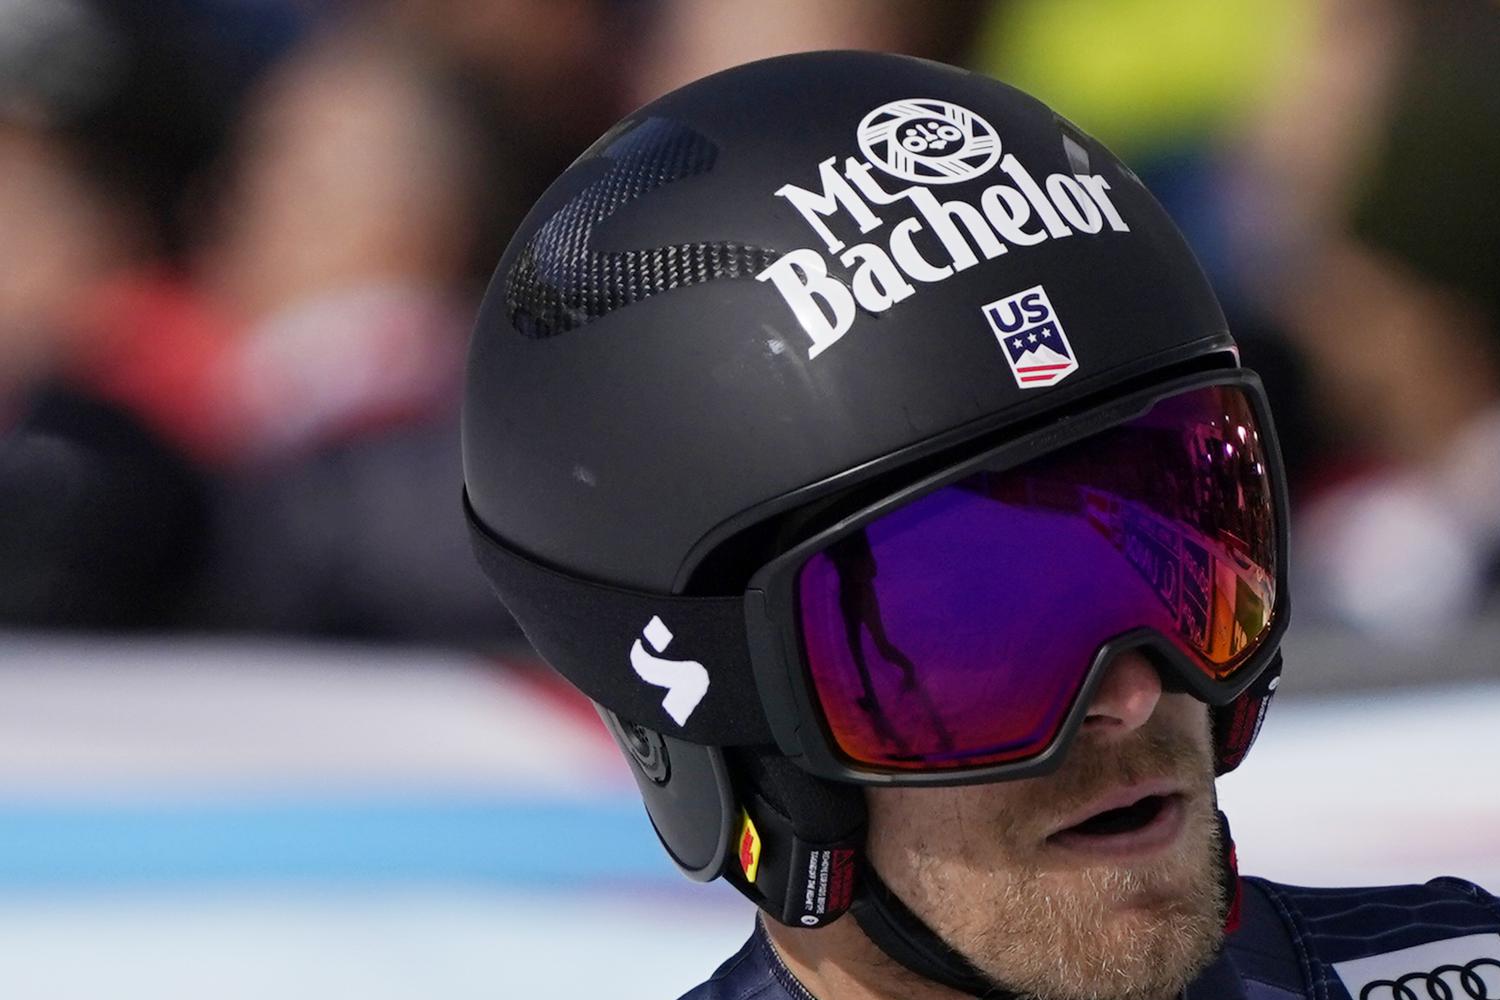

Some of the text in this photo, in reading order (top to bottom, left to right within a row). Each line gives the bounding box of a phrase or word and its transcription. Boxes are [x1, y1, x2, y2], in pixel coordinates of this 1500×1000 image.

[774, 154, 909, 255] Mt
[755, 153, 1130, 360] Bachelor
[991, 292, 1051, 334] US
